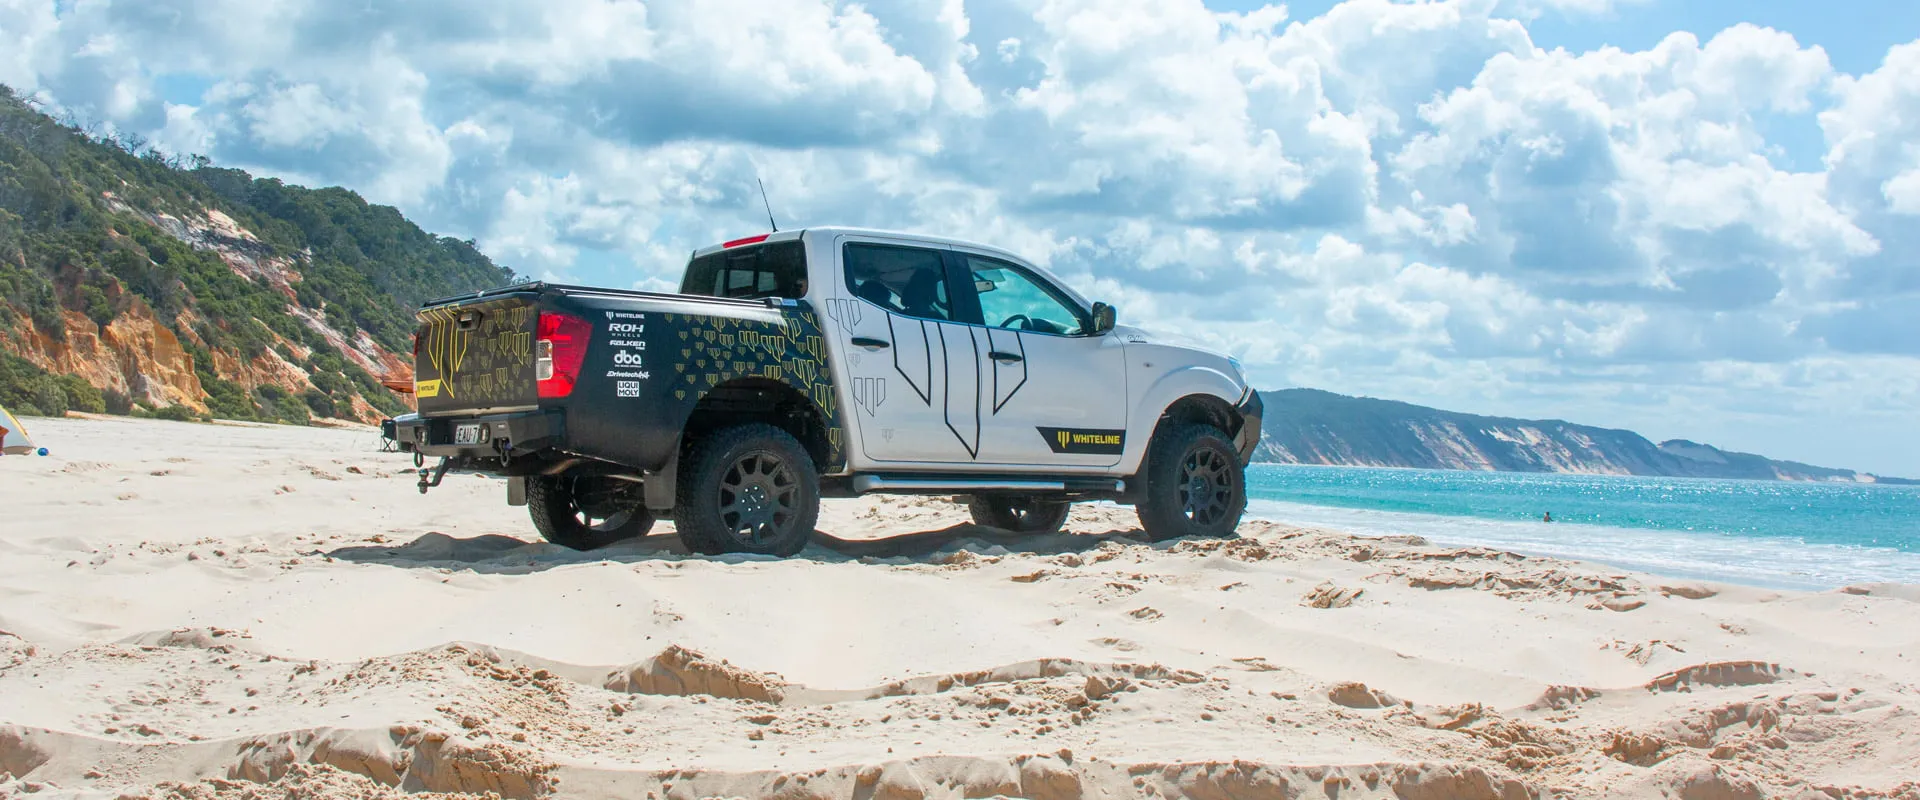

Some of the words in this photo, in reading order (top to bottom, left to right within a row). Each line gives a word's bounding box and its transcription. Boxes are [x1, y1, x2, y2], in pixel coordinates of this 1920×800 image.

[609, 323, 644, 333] ROH
[614, 350, 642, 365] dba
[618, 381, 639, 389] LIQUI
[1072, 434, 1120, 444] WHITELINE
